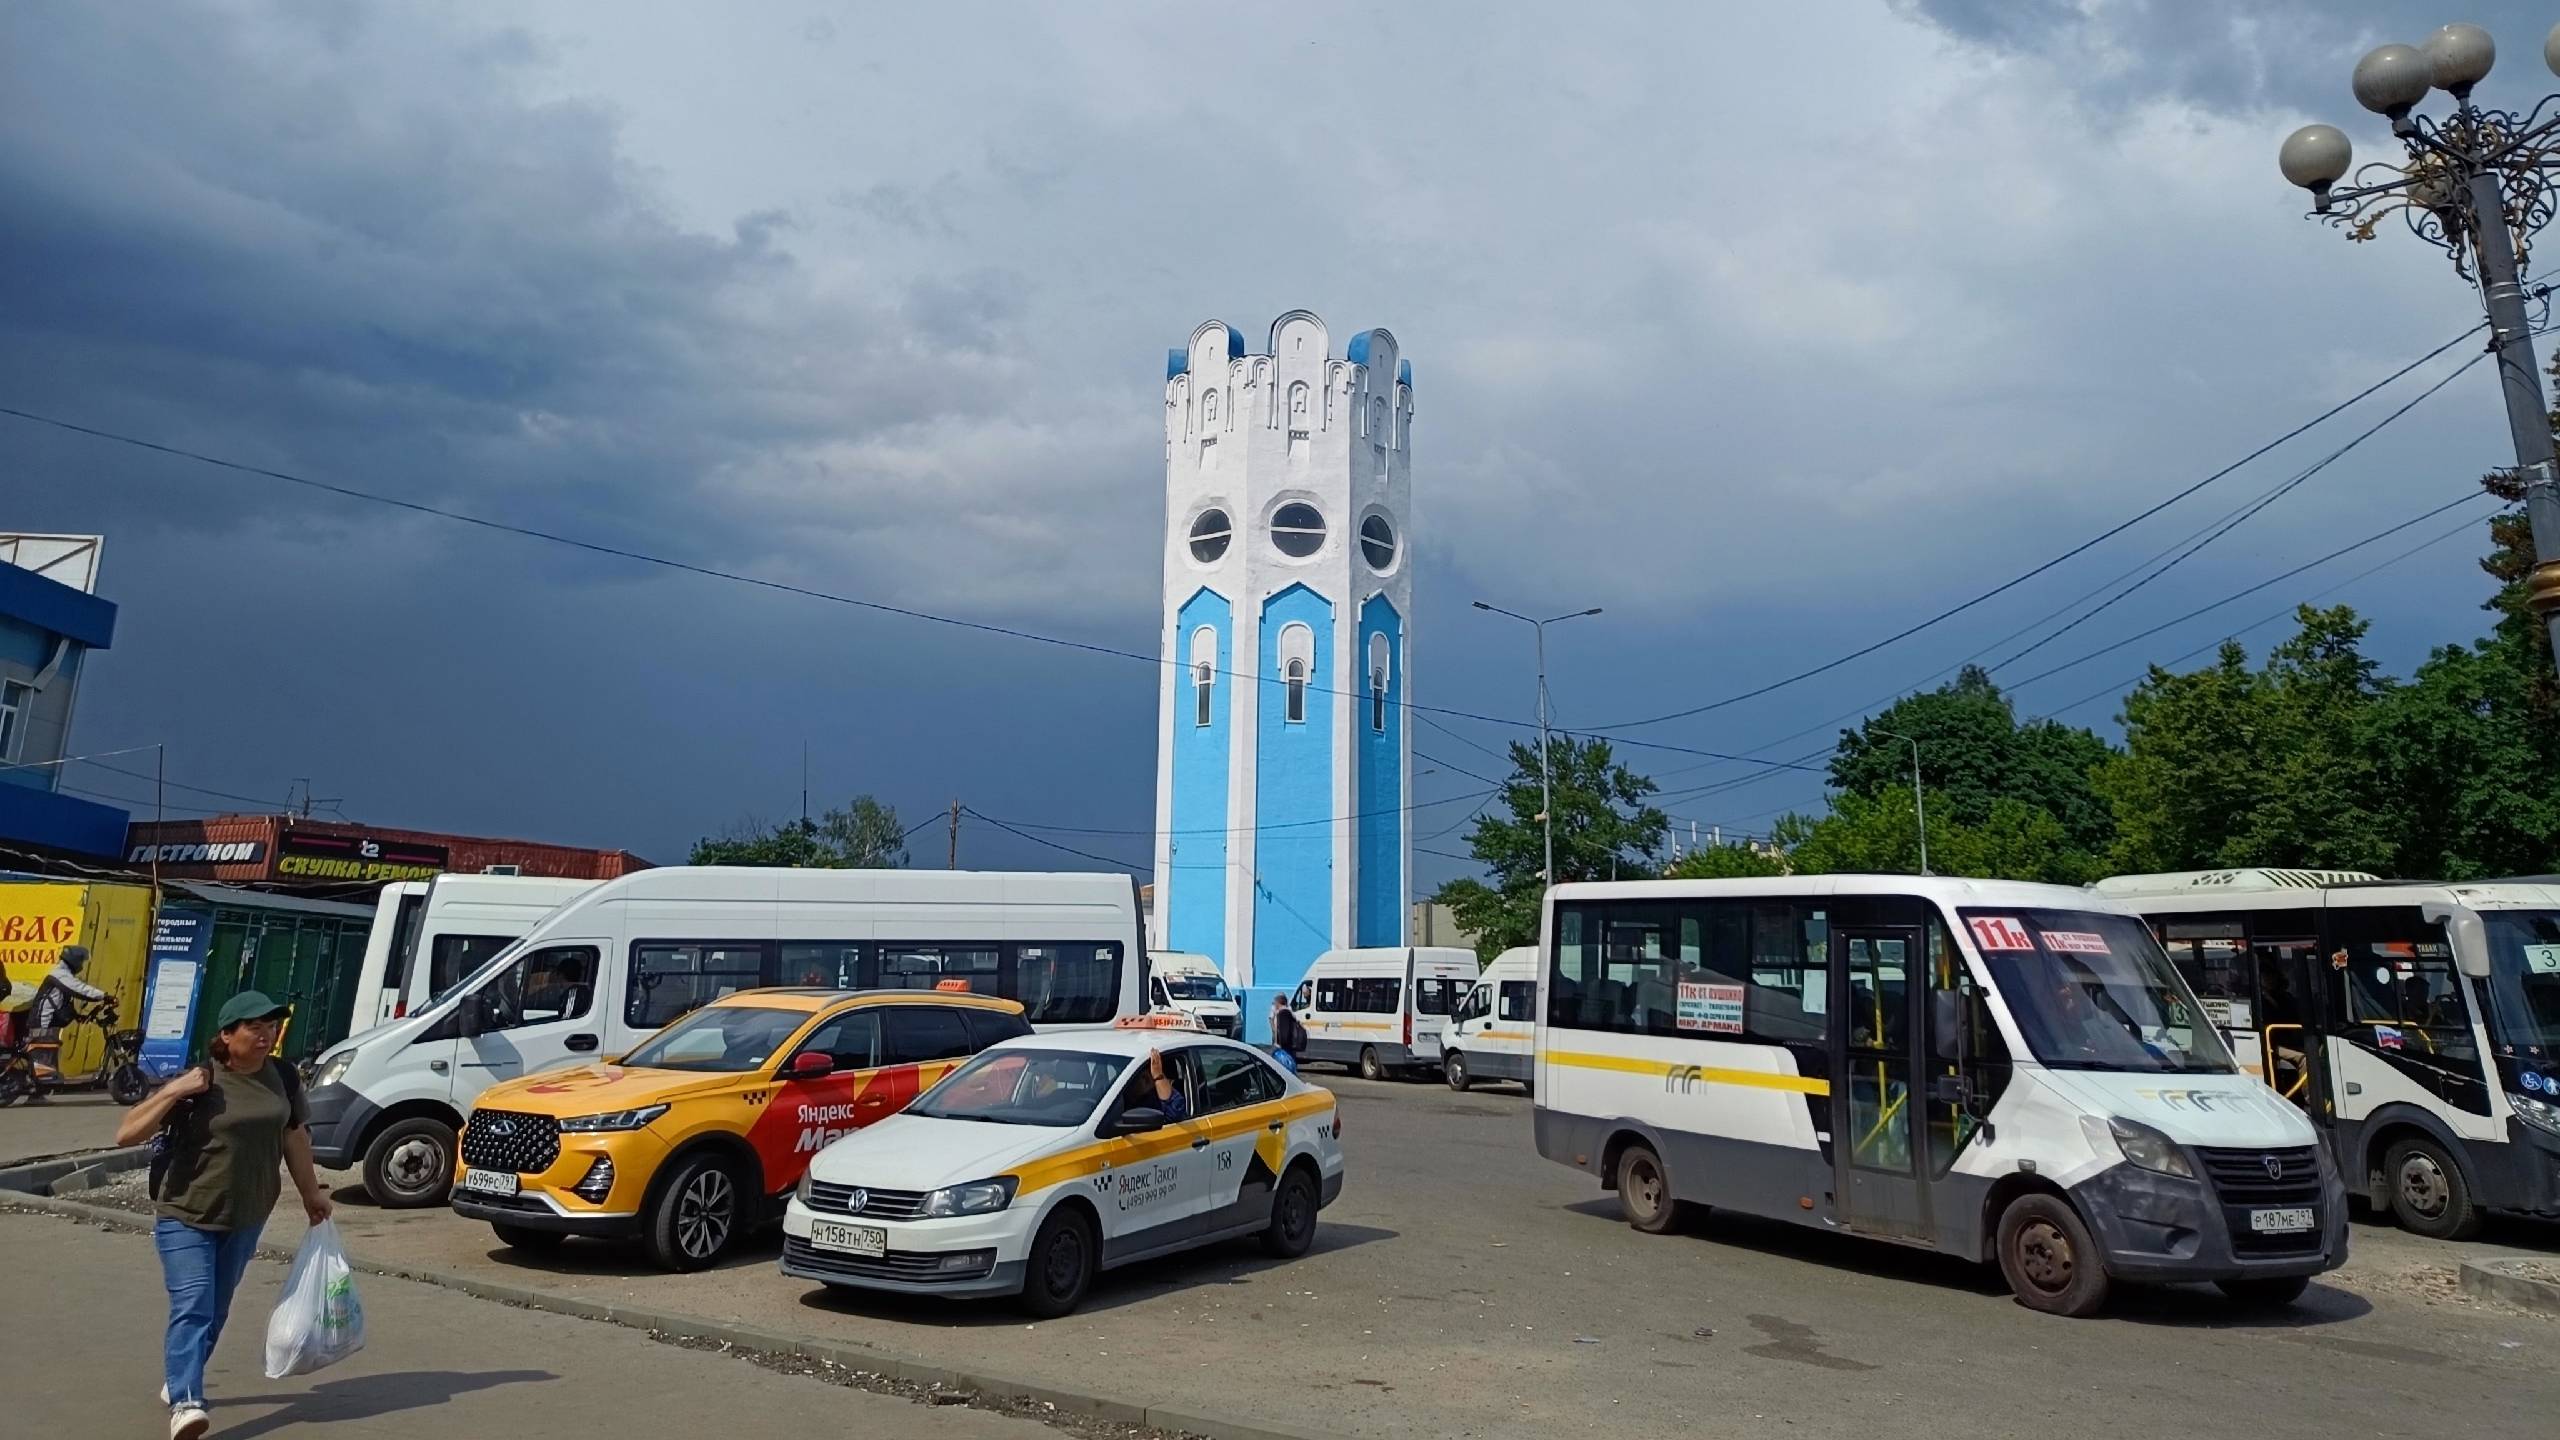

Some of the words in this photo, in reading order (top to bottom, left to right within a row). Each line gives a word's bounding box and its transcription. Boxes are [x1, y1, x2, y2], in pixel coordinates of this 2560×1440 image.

[128, 843, 255, 862] ГАСТРОНОМ
[0, 915, 74, 943] ВАС
[157, 918, 197, 927] городные
[798, 1103, 855, 1124] Яндекс
[794, 1126, 861, 1152] Ма
[1217, 1150, 1232, 1171] 158
[1119, 1170, 1152, 1195] Яндекс
[1153, 1164, 1178, 1185] Такси
